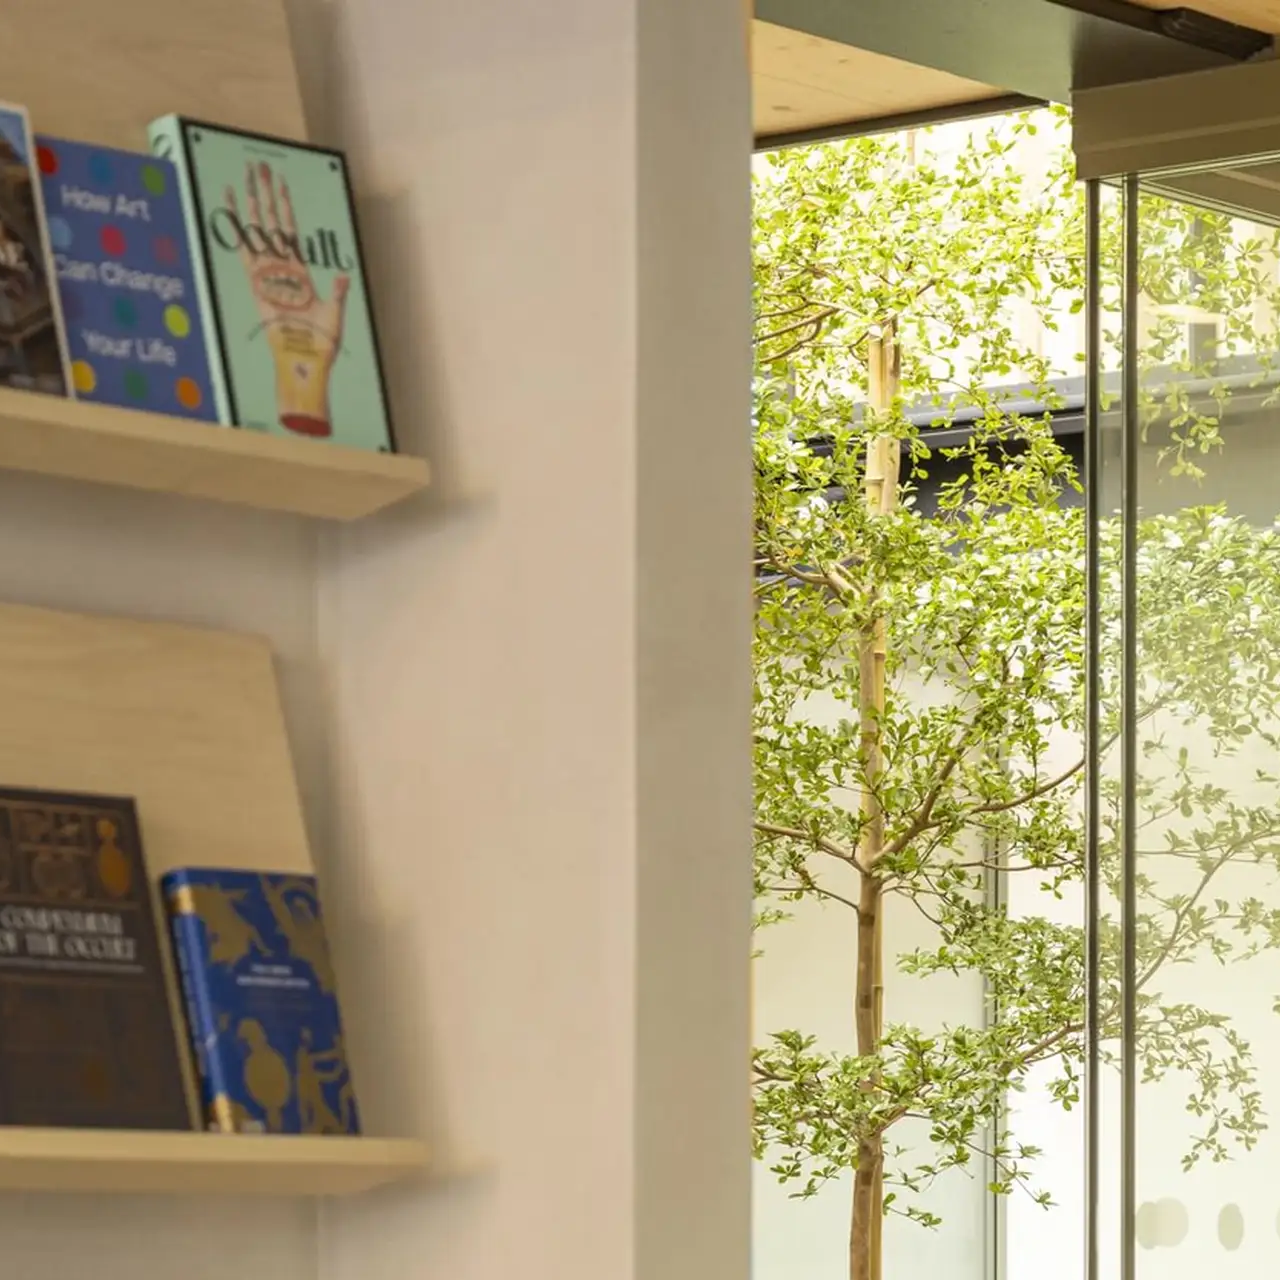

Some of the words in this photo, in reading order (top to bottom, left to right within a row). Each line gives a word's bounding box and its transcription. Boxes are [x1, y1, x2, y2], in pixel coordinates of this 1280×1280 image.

[60, 184, 111, 214] How
[115, 192, 152, 223] Art
[209, 206, 355, 272] Occult
[53, 252, 98, 283] Can
[99, 260, 185, 300] Change
[81, 328, 134, 361] Your
[136, 337, 178, 367] Life
